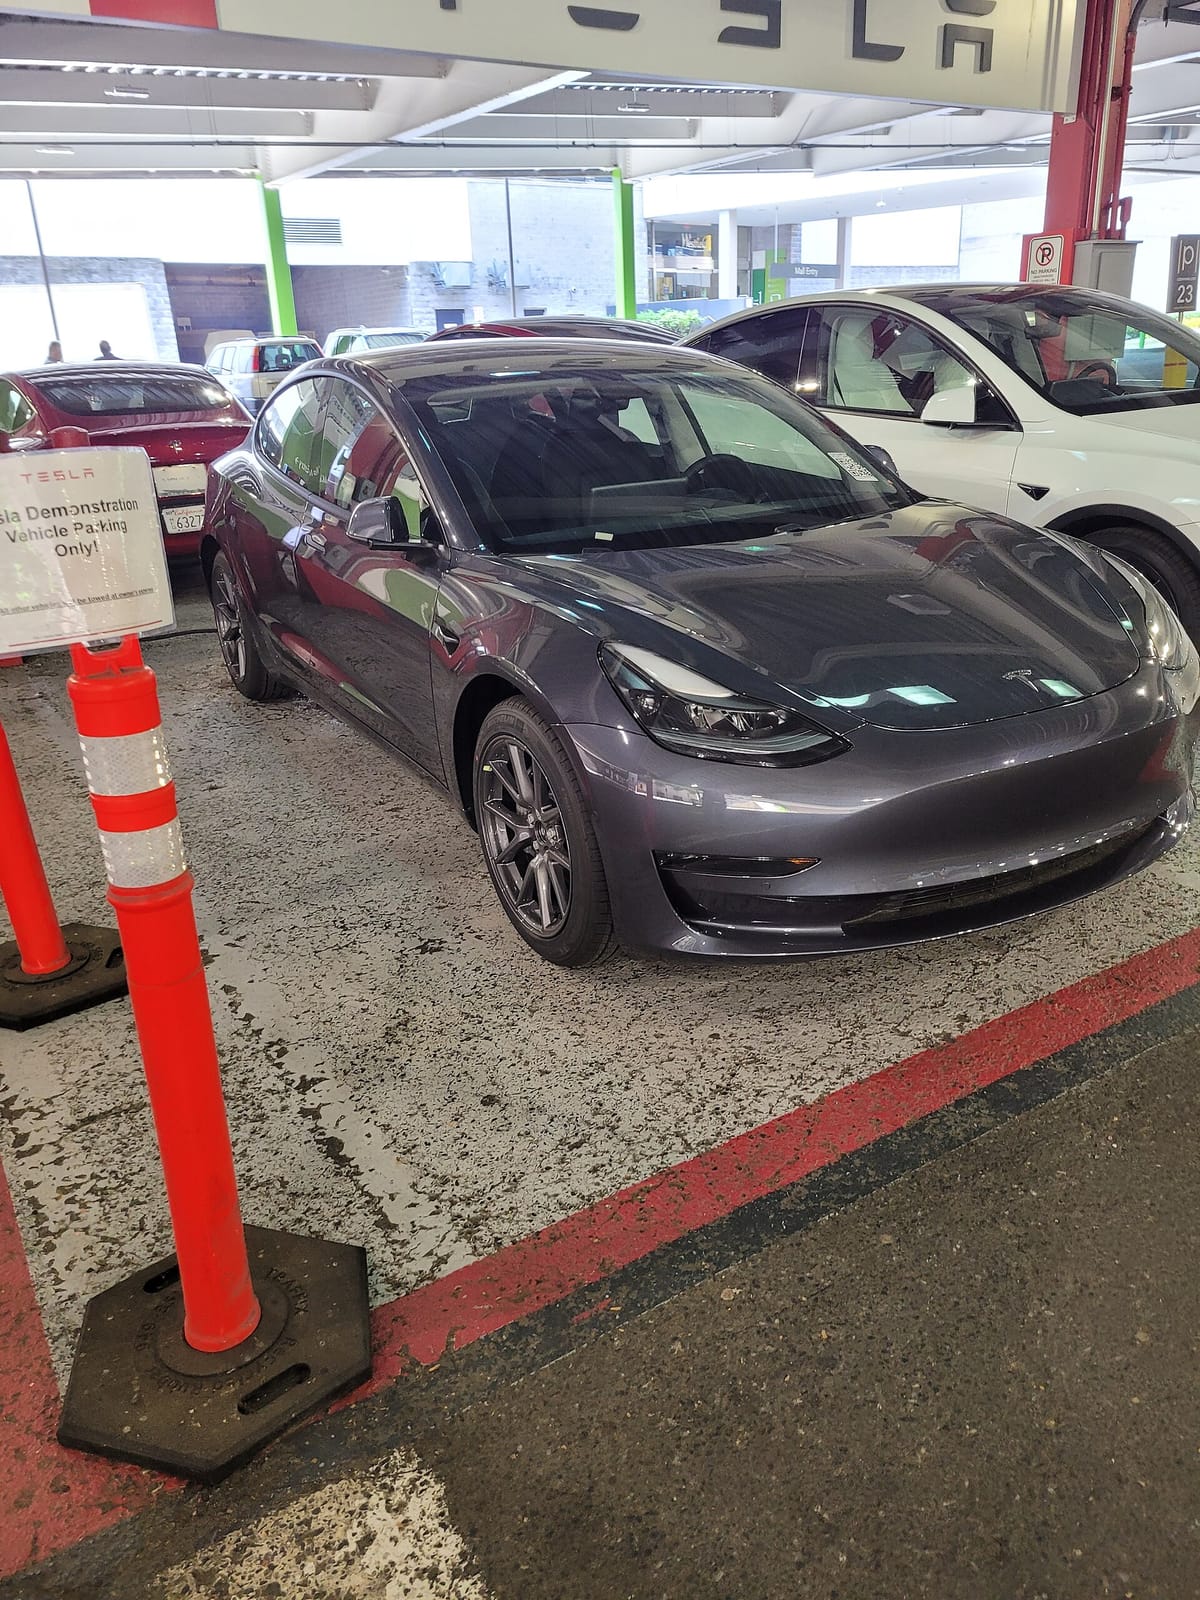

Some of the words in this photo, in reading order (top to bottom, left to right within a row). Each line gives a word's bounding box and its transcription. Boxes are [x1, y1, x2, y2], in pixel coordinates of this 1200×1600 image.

[441, 0, 995, 71] SLA
[1177, 284, 1193, 303] 23
[20, 467, 95, 484] TESLA
[25, 498, 139, 521] Demonstration
[5, 524, 69, 543] Vehicle
[73, 519, 127, 534] Parking
[176, 514, 204, 529] 6327
[54, 540, 99, 557] Only!
